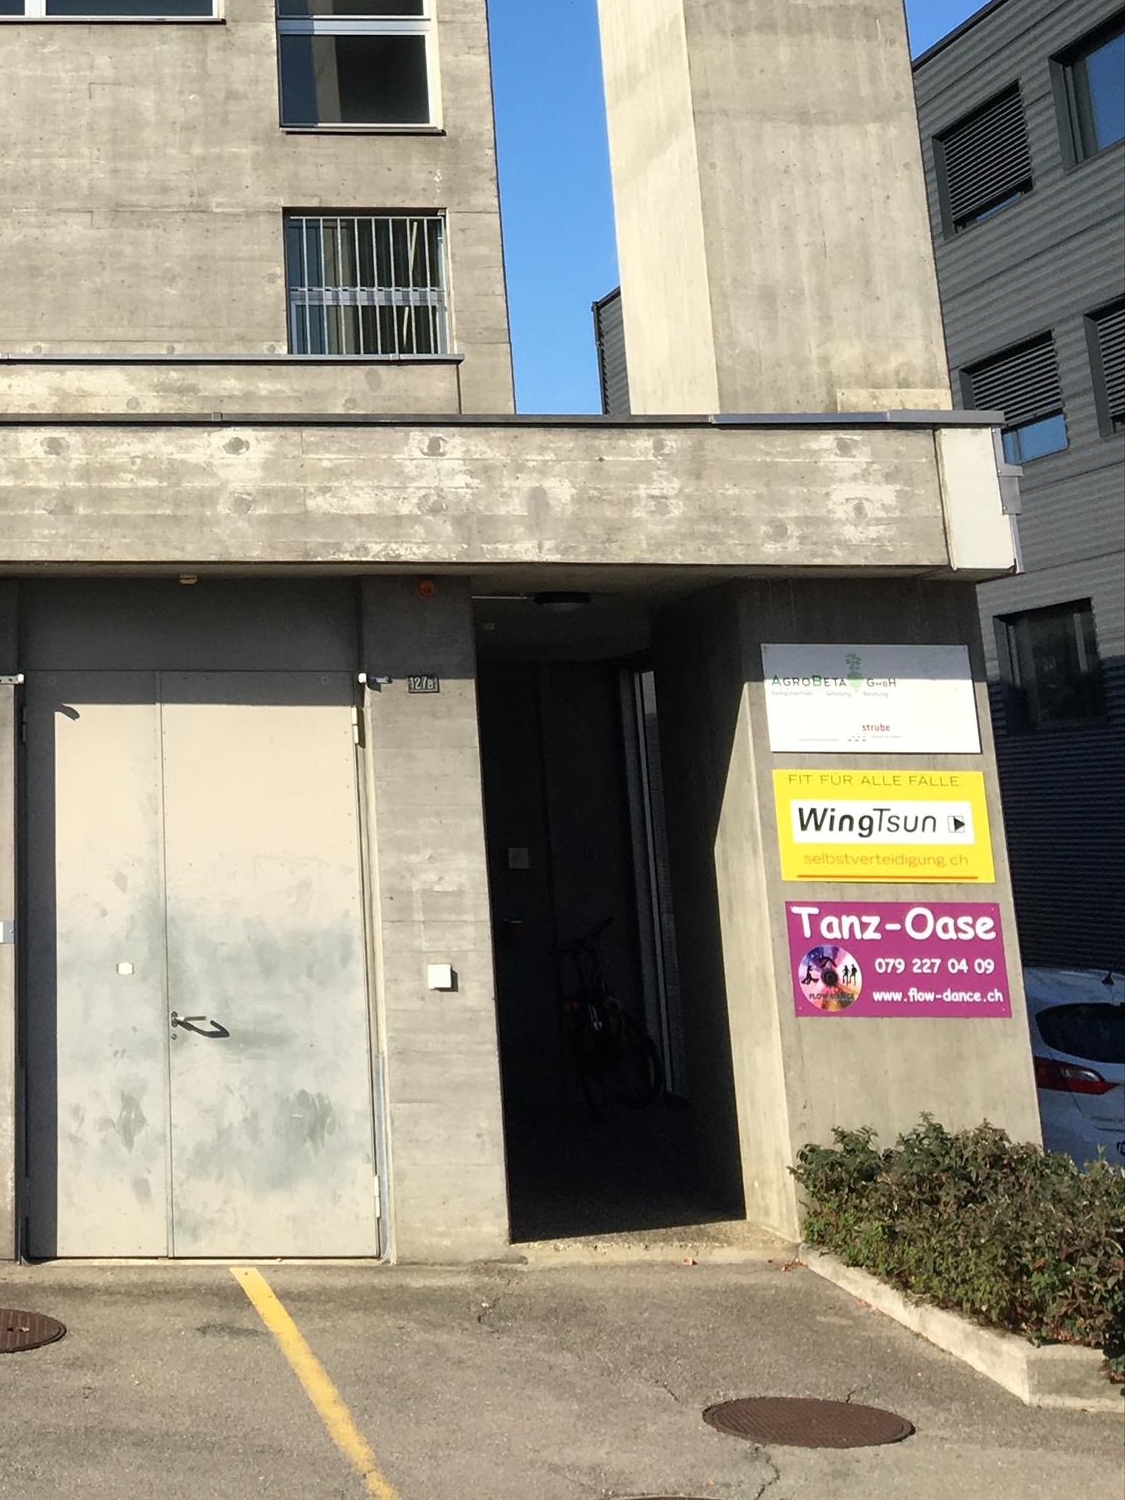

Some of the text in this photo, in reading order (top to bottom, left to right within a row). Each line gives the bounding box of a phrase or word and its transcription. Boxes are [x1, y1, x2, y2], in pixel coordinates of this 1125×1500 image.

[861, 723, 891, 732] strube
[788, 774, 813, 785] FIT
[820, 771, 853, 786] FÜR
[860, 775, 903, 786] ALLE
[797, 807, 938, 838] WingTsun
[803, 852, 969, 868] selbstverteidigung.ch
[790, 906, 997, 941] Tanz-Oase
[875, 958, 995, 974] 079 227 04 09
[872, 987, 1004, 1003] www.flow-dance.ch
